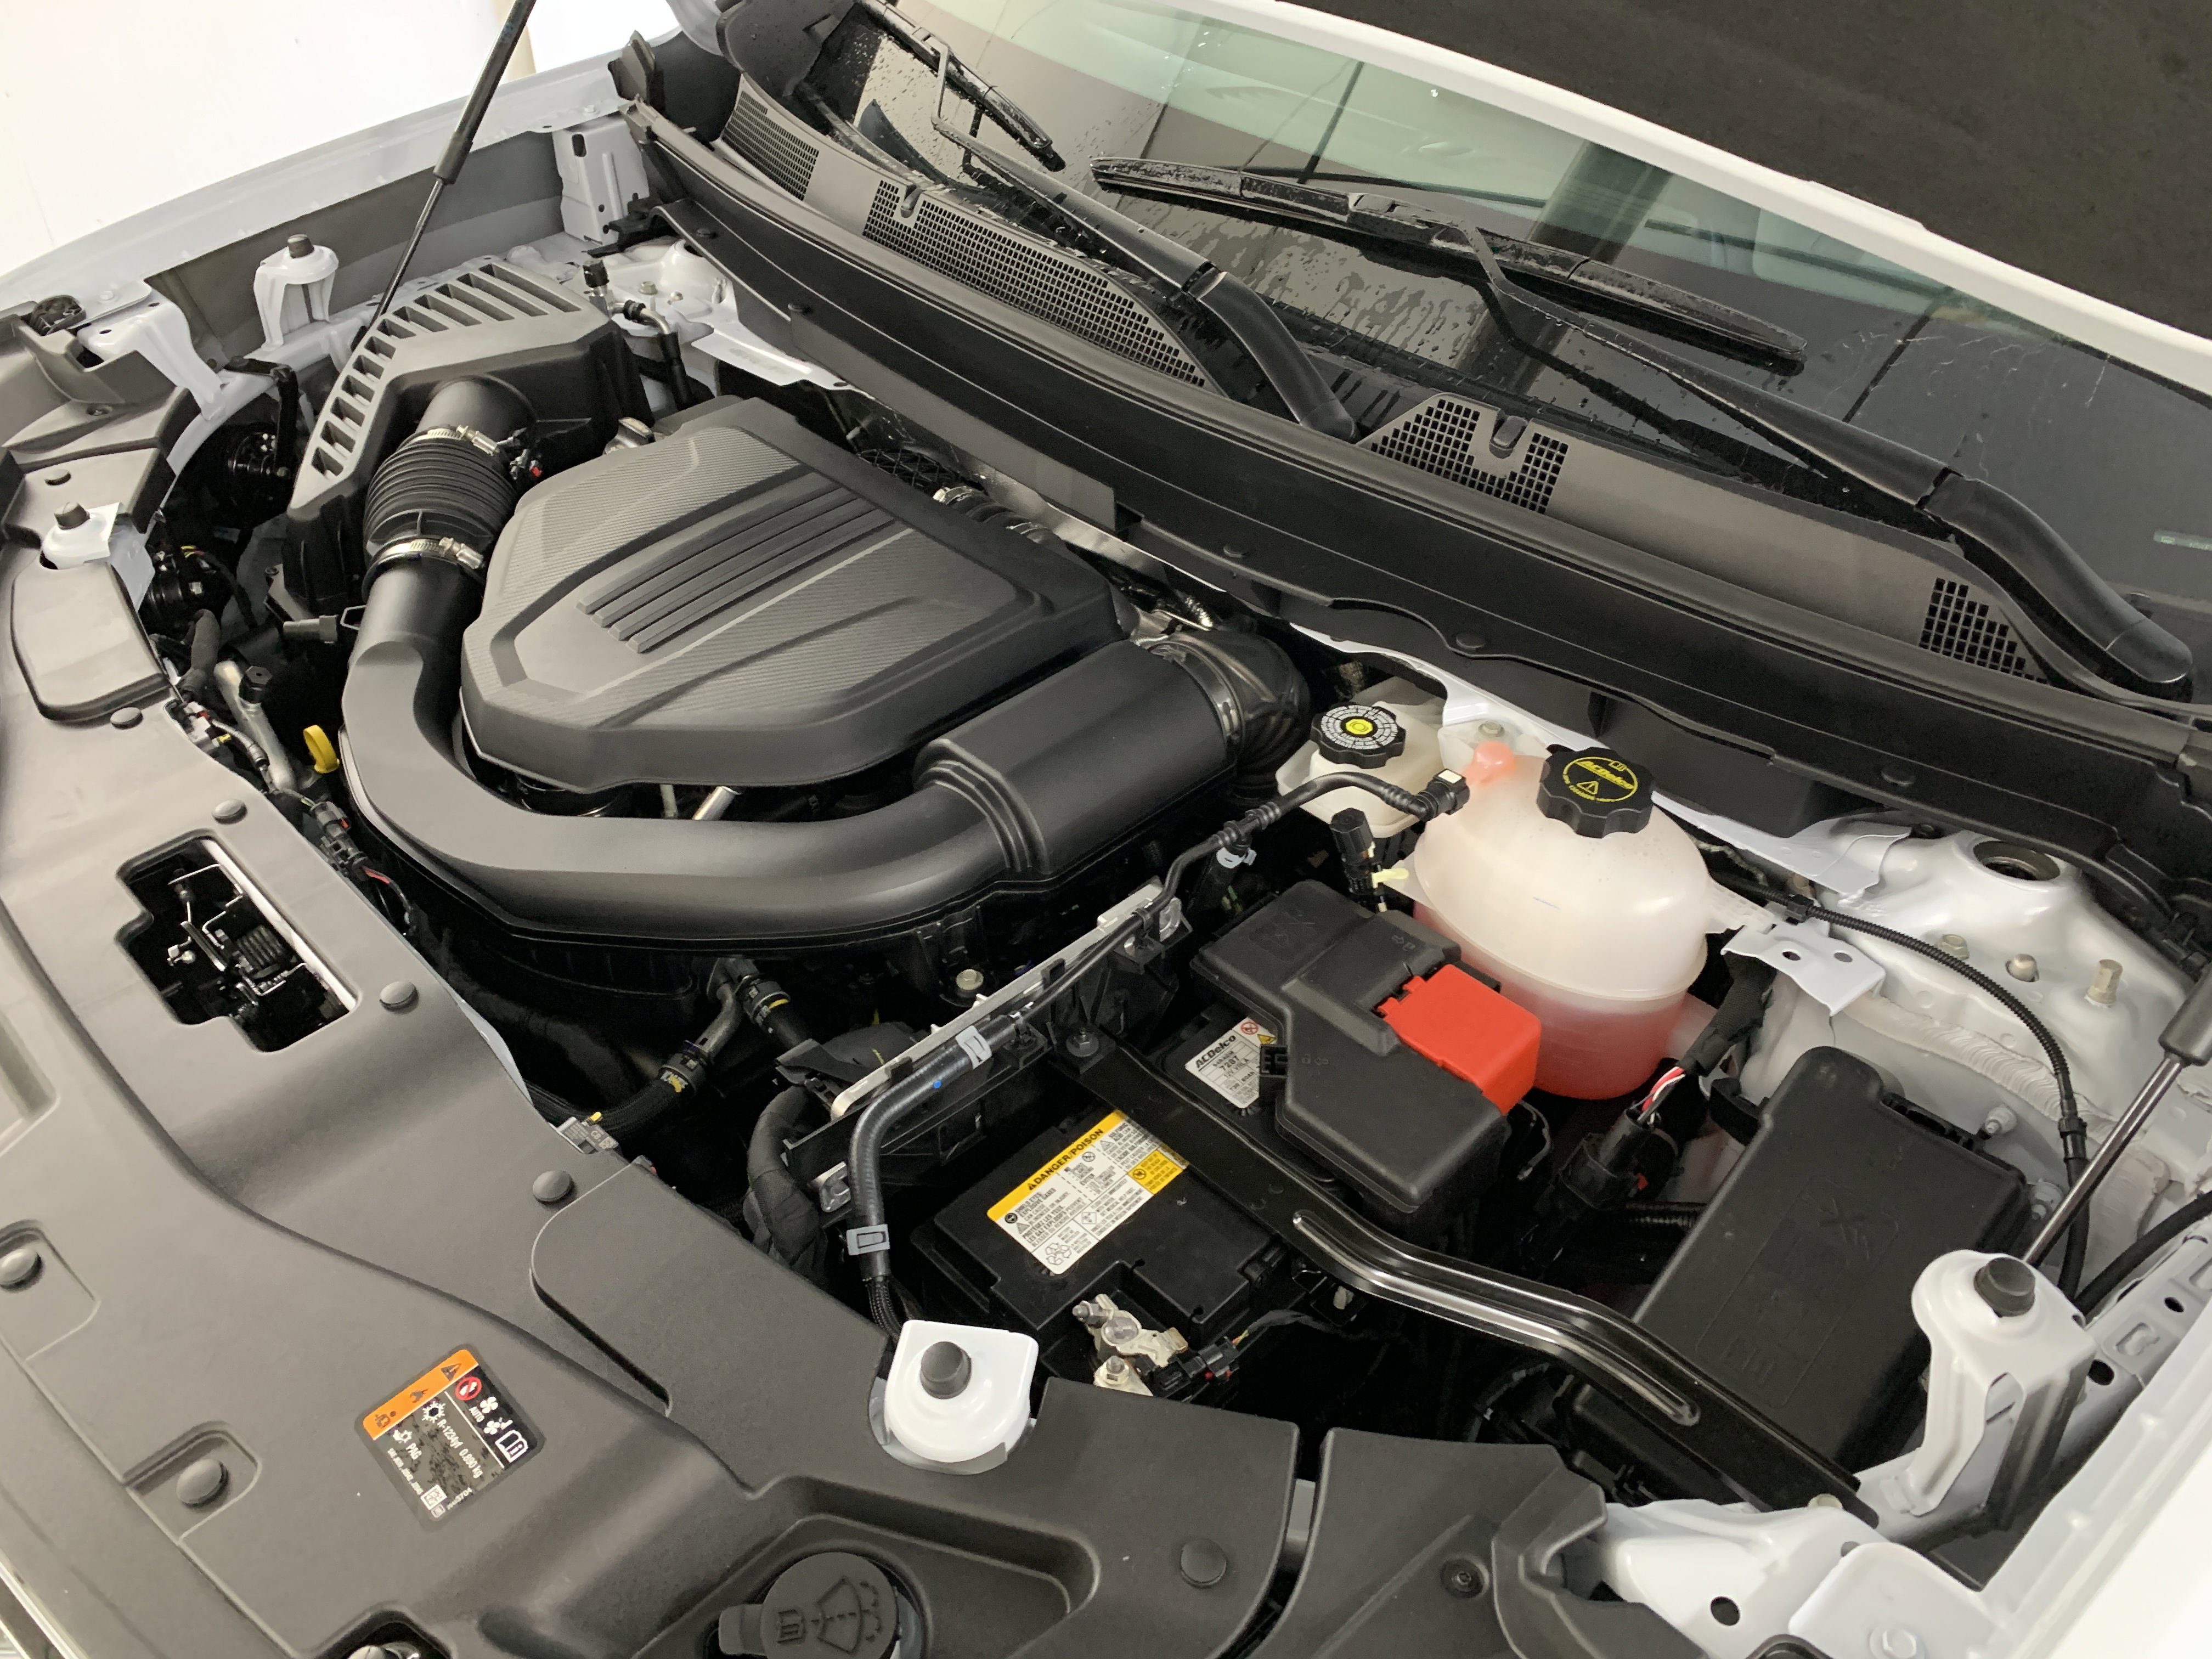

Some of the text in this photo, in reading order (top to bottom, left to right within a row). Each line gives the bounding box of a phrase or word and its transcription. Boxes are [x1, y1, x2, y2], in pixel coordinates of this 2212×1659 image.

[1194, 1035, 1237, 1068] ACDelco
[1218, 1054, 1240, 1072] 7287
[1223, 1069, 1235, 1078] 12V
[1032, 1127, 1104, 1184] DANGER/POISON
[468, 1405, 485, 1423] AUTO
[405, 1442, 423, 1460] PAG
[435, 1418, 485, 1480] R-1234yf 0.890 kg
